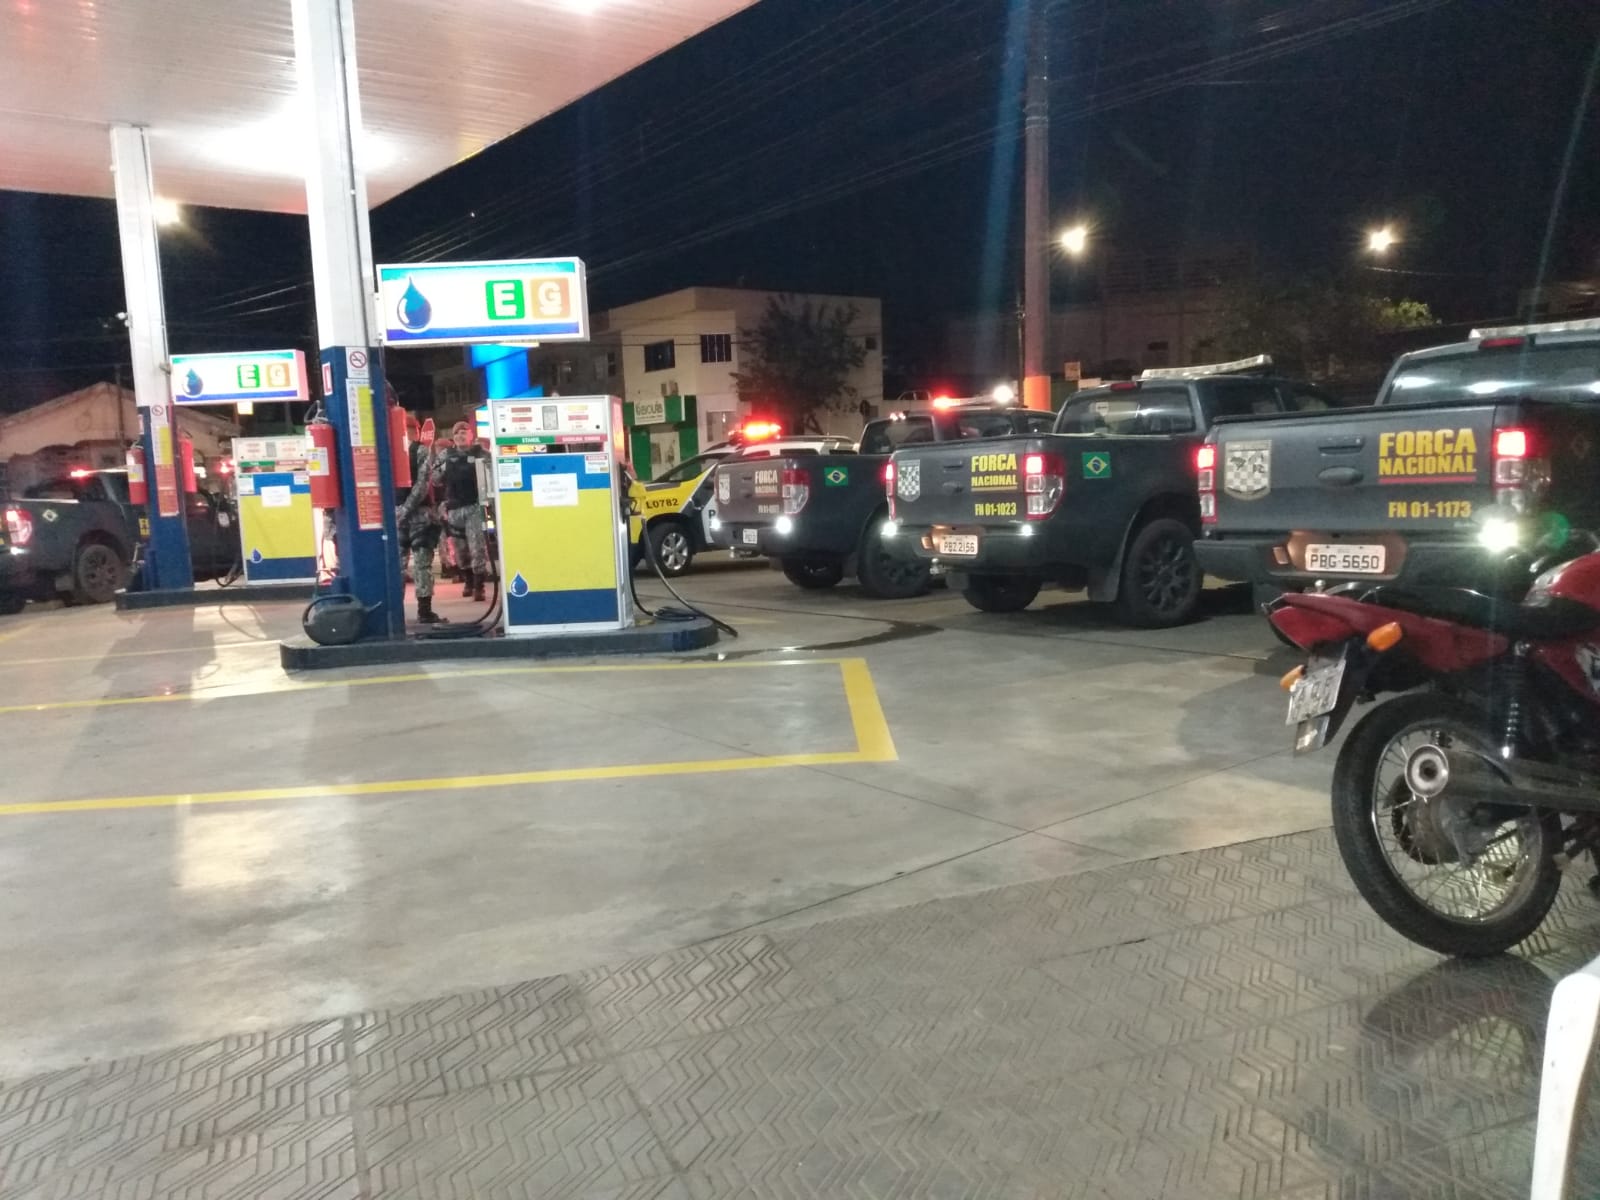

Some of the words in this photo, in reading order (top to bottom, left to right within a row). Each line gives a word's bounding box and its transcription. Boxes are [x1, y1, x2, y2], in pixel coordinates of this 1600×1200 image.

[493, 282, 518, 316] E
[240, 365, 257, 387] E
[1379, 454, 1477, 475] NACIONAL
[971, 474, 1018, 487] NACIONAL
[1388, 501, 1407, 518] FN
[1311, 554, 1337, 568] PBG
